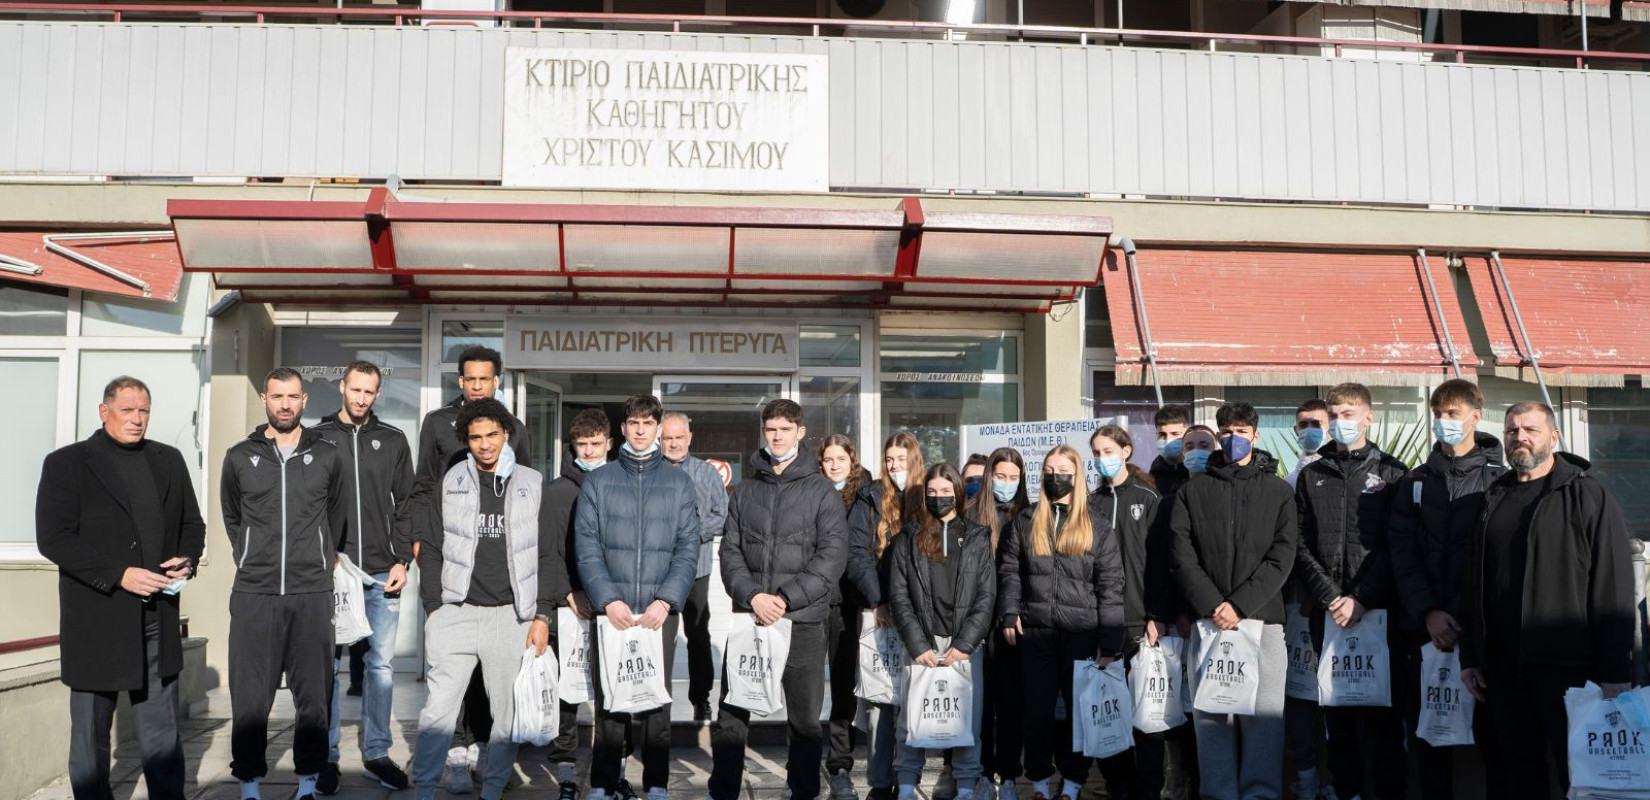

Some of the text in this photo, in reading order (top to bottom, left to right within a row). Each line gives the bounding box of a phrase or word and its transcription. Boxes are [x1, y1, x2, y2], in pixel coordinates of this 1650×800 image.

[525, 58, 808, 92] ΚΤΙΡΙΟ ΠΑΙΔΙΑΤΡΙΚΗΣ
[586, 98, 749, 130] ΚΑΘΗΓΗΤΟΥ
[541, 137, 790, 170] ΧΡΙΣΤΟΥ ΚΑΣΙΜΟΥ
[519, 330, 788, 354] ΠΑΙΔΙΑΤΡΙΚΗ ΠΤΕΡΥΓΑ
[979, 426, 1010, 436] ΜΟΝΑΔΑ
[1012, 424, 1053, 434] ΕΝΤΑΤΙΚΗΣ
[1008, 437, 1036, 447] ΠΑΙΔΩΝ
[478, 514, 504, 528] AOK
[1206, 658, 1246, 677] PAOK
[1331, 655, 1375, 670] PAOK
[1146, 677, 1174, 692] AOK
[923, 697, 960, 712] PAOK
[1587, 729, 1643, 747] PAOK
[1588, 746, 1646, 756] BASKETBALL
